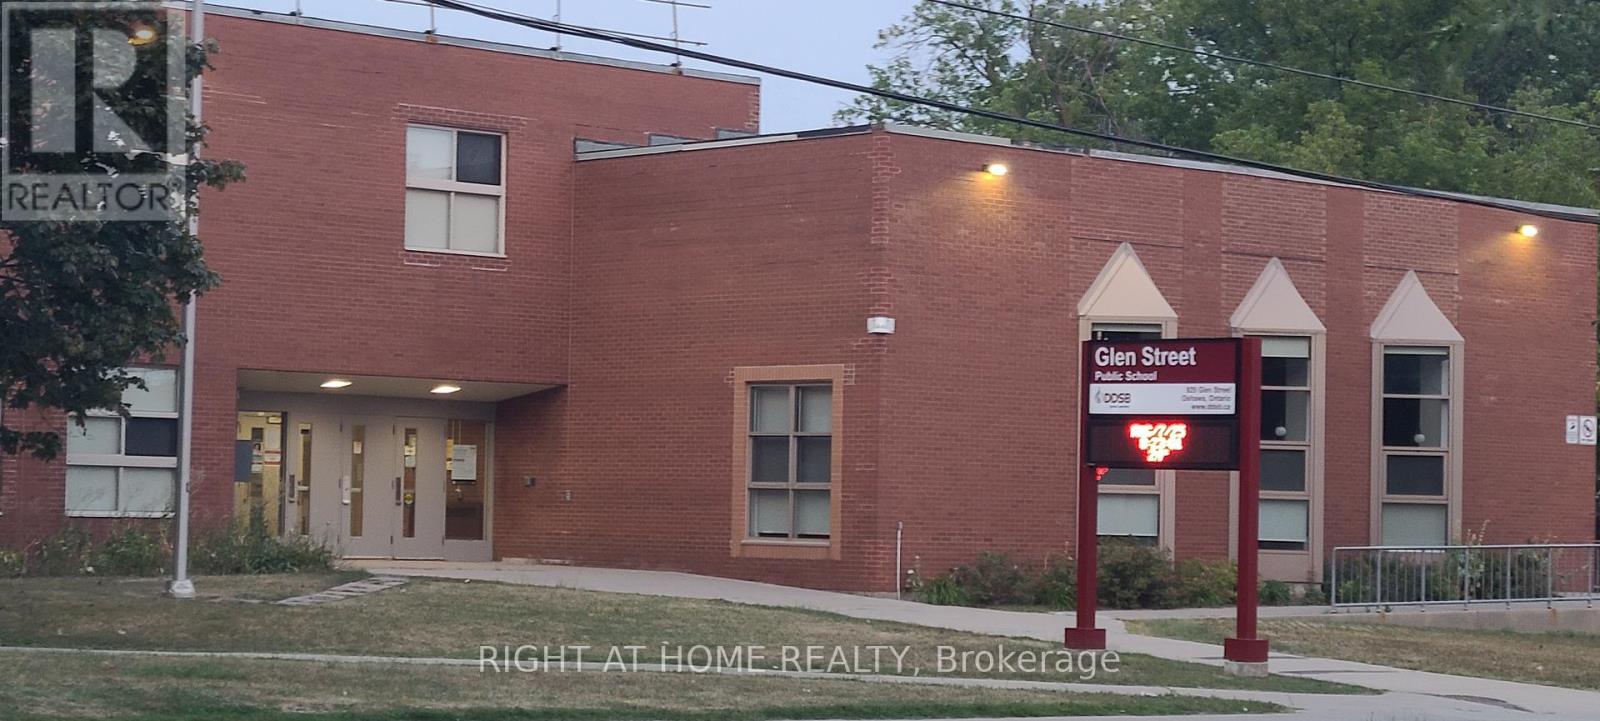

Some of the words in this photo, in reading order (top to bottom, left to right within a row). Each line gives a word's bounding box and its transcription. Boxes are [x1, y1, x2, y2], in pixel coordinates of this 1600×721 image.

[1094, 346, 1137, 367] Glen
[1141, 346, 1197, 366] Street
[1094, 371, 1124, 381] Public
[1125, 371, 1158, 381] School
